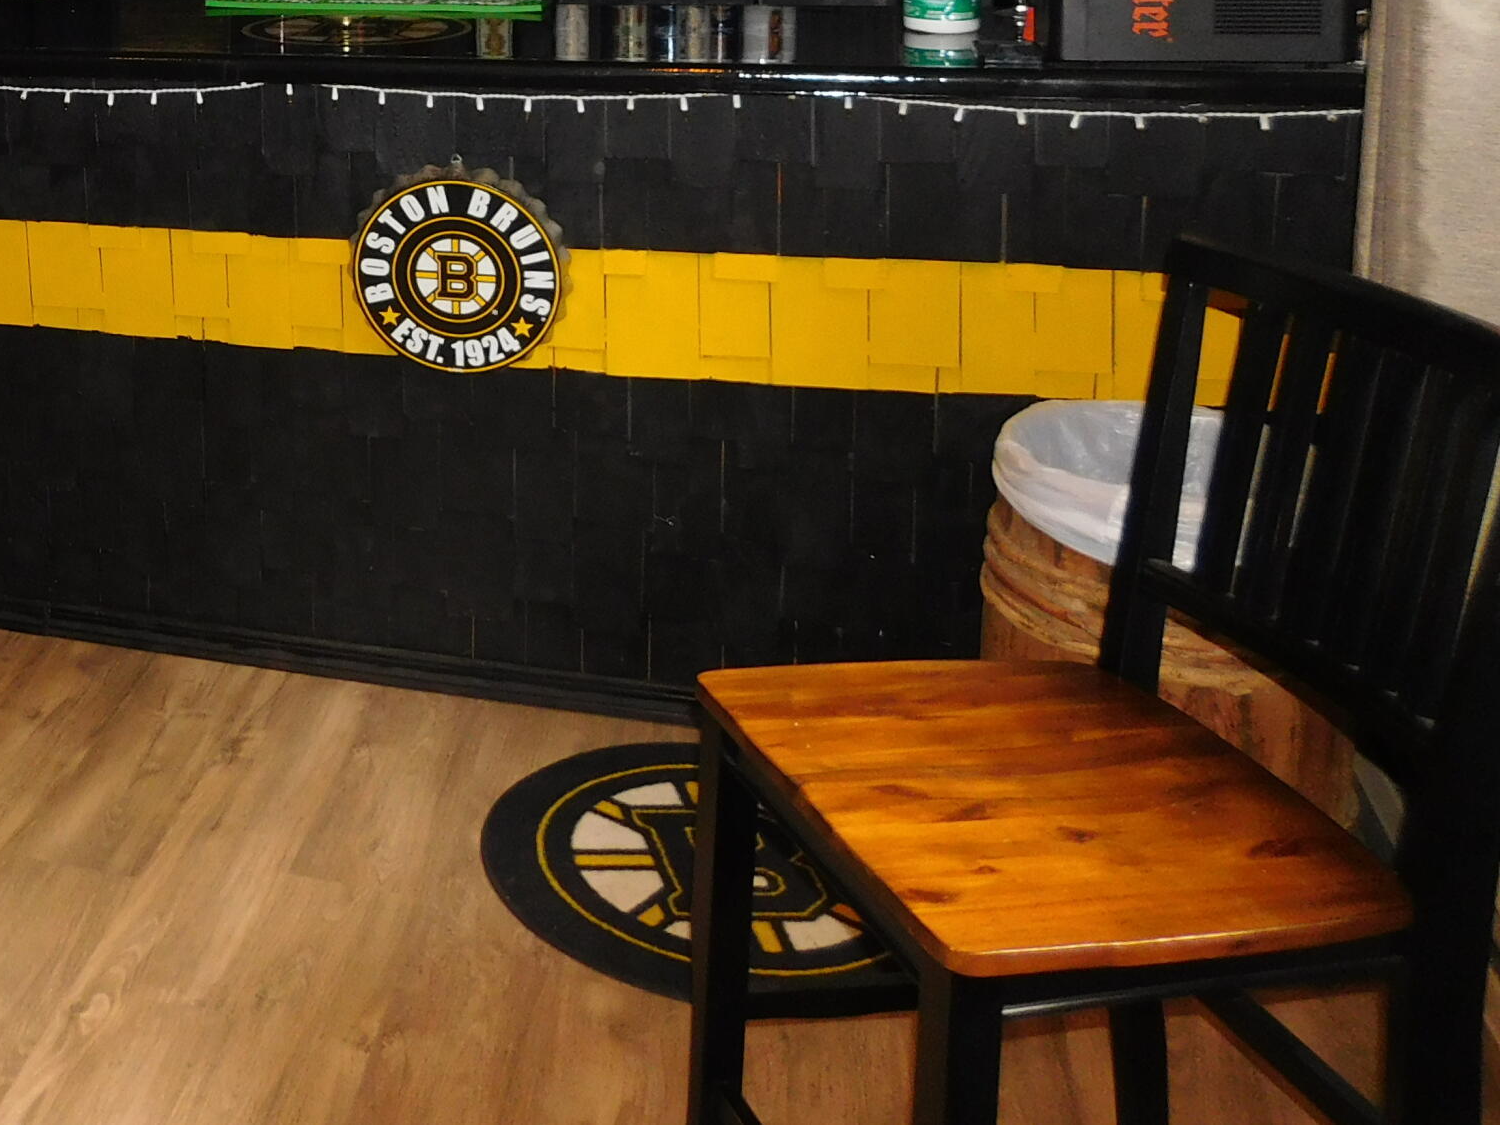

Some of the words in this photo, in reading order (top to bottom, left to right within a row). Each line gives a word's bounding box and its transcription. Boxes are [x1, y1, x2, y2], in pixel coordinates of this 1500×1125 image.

[360, 185, 450, 305] BOSTON
[467, 188, 555, 316] BRUINS
[435, 251, 477, 301] B
[391, 318, 445, 364] EST.
[451, 327, 522, 367] 1924
